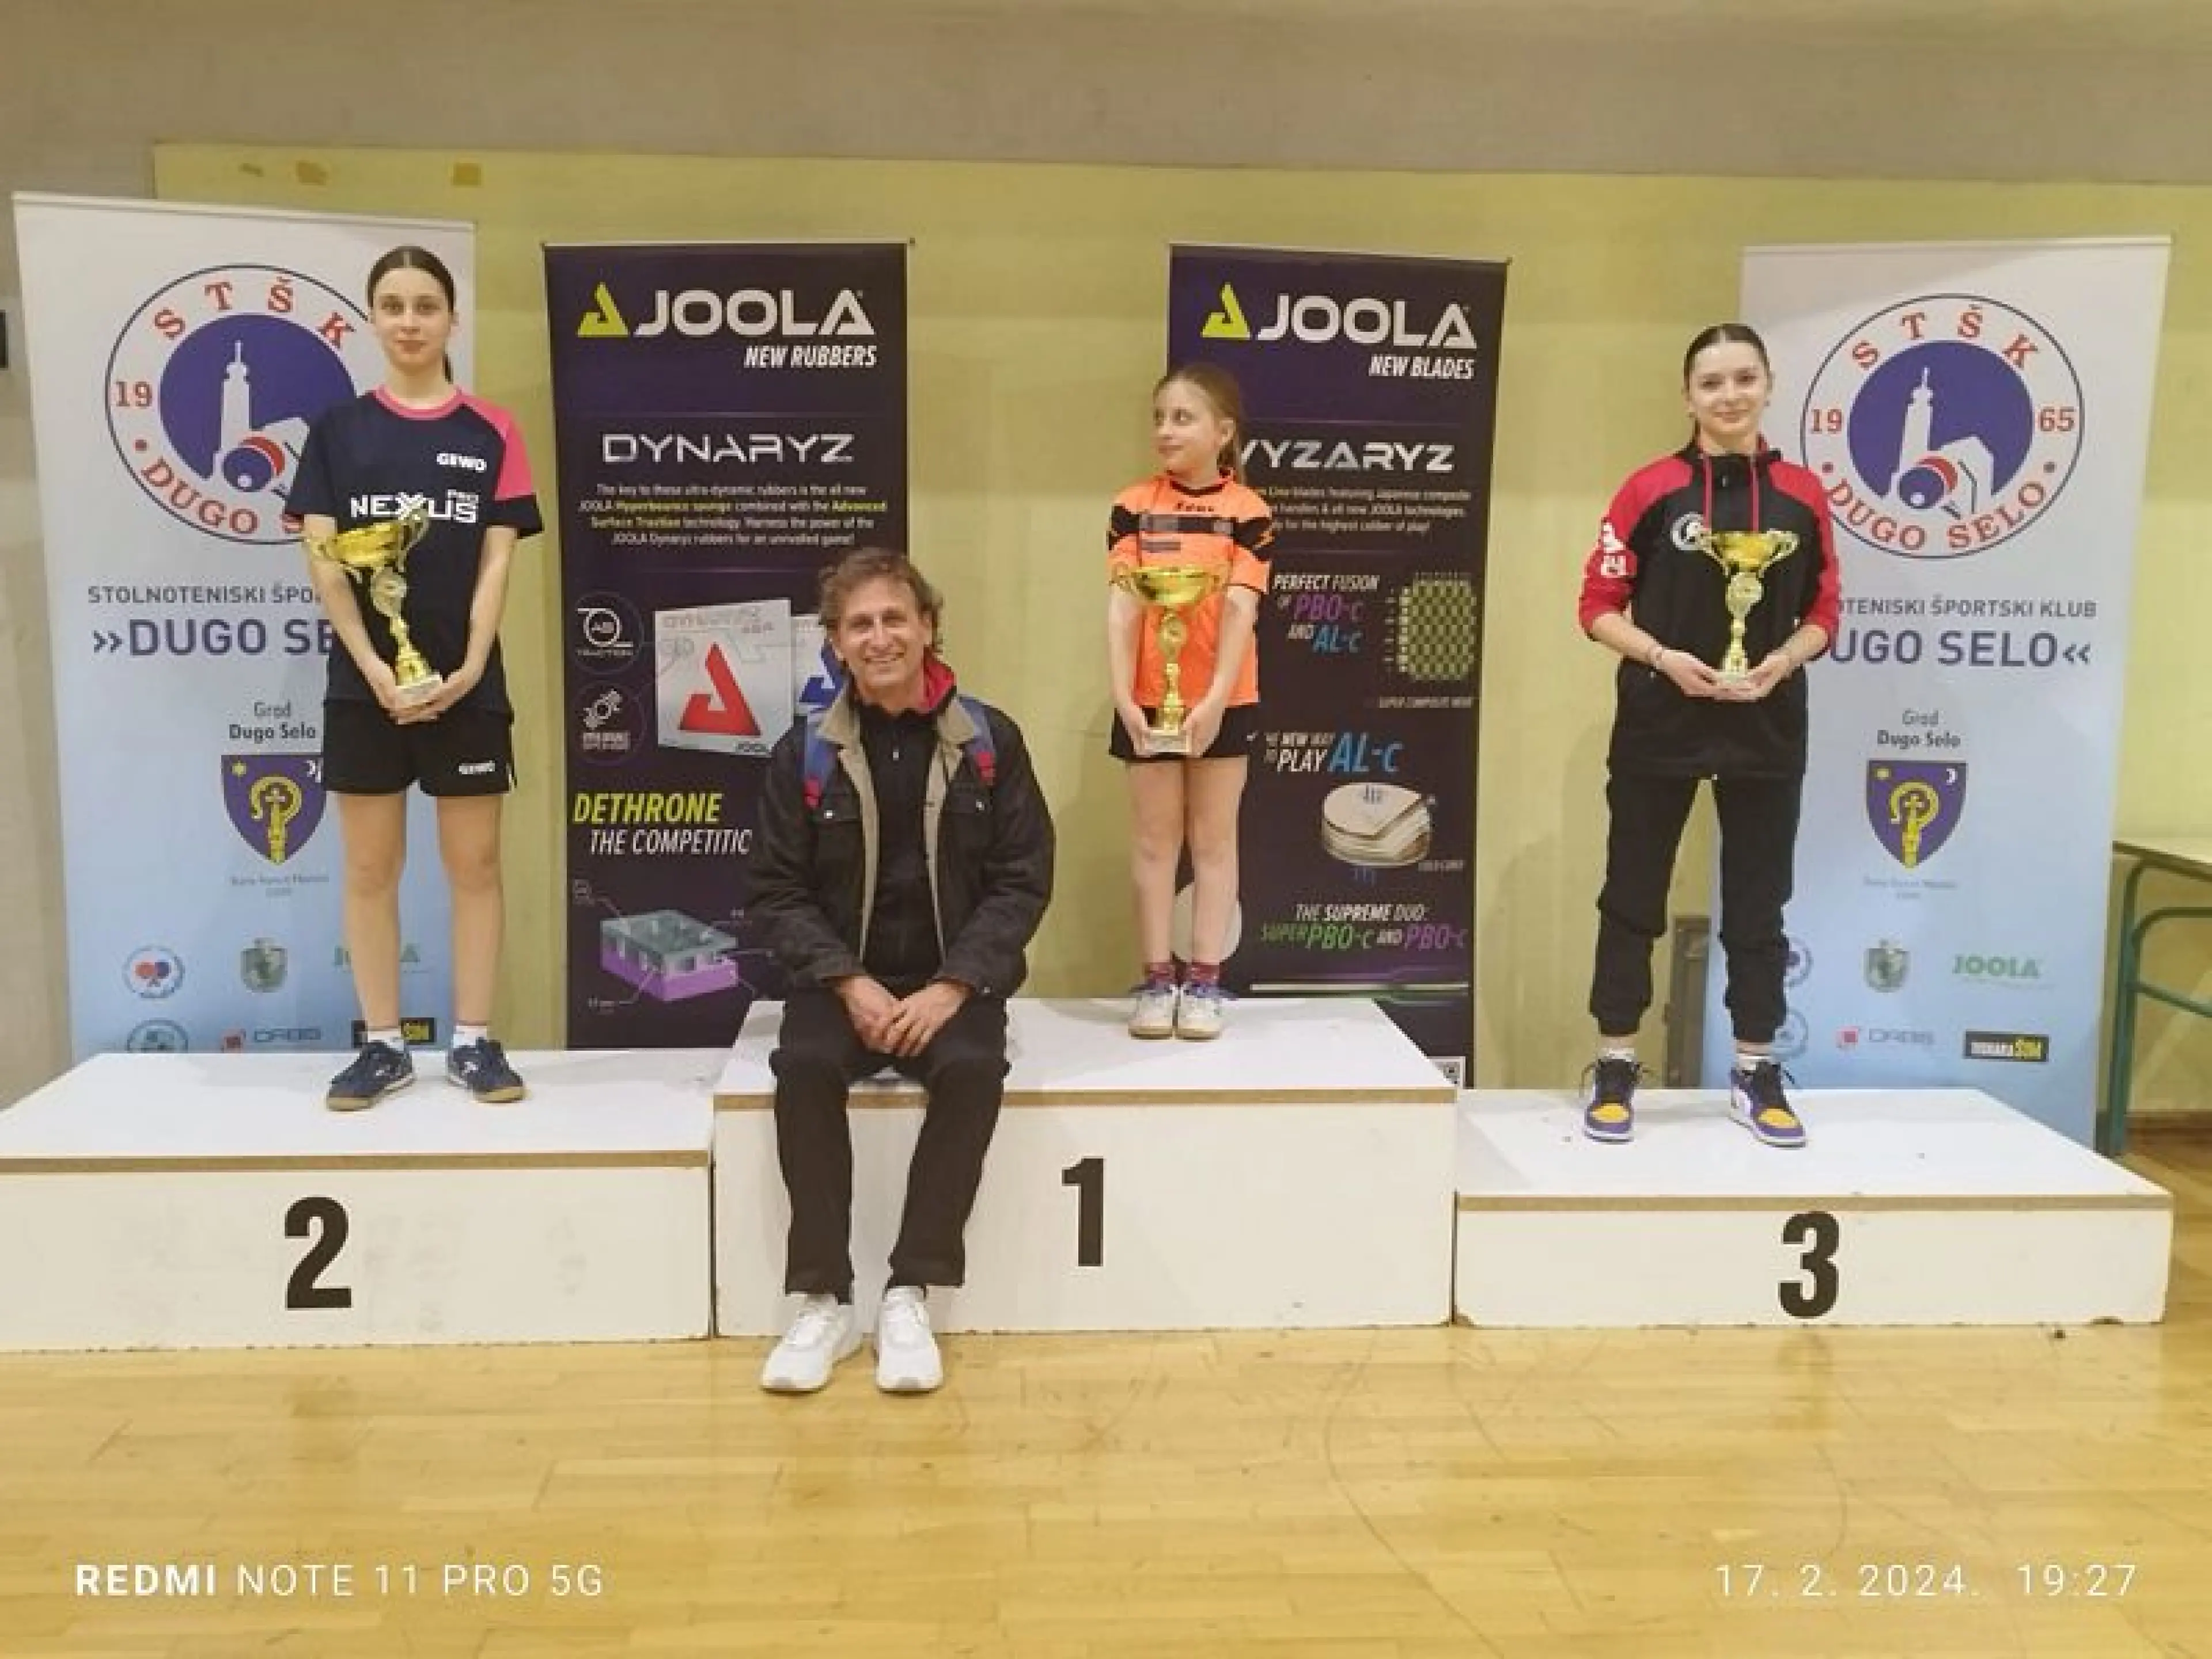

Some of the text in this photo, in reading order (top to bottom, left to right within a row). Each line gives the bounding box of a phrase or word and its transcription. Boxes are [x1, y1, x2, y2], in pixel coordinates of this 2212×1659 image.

[634, 289, 875, 338] JOOLA
[1257, 293, 1477, 349] JOOLA
[744, 346, 877, 368] NEW RUBBERS
[1369, 354, 1475, 380] NEW BLADES
[115, 381, 153, 407] 19
[1811, 408, 1843, 433] 19
[2039, 407, 2075, 432] 65
[602, 433, 855, 464] DYNARYZ
[141, 456, 258, 535] DUGO
[1827, 479, 2047, 551] DUGO SELO
[88, 582, 321, 603] STOLNOTENISKI ŠPO
[1272, 575, 1331, 590] PERFECT
[1930, 592, 2033, 617] ŠPORTSKI
[2039, 599, 2098, 619] KLUB
[283, 619, 333, 656] SE
[1830, 629, 1923, 665] UGO
[229, 722, 316, 744] Dugo Selo
[1277, 749, 1328, 772] PLAY
[574, 792, 725, 825] DETHRONE
[591, 828, 629, 855] THE
[1296, 903, 1323, 922] THE
[1324, 903, 1393, 922] SUPREME
[1951, 953, 2041, 978] JOOLA
[1061, 1158, 1105, 1267] 1
[284, 1196, 352, 1310] 2
[1778, 1210, 1839, 1319] 3
